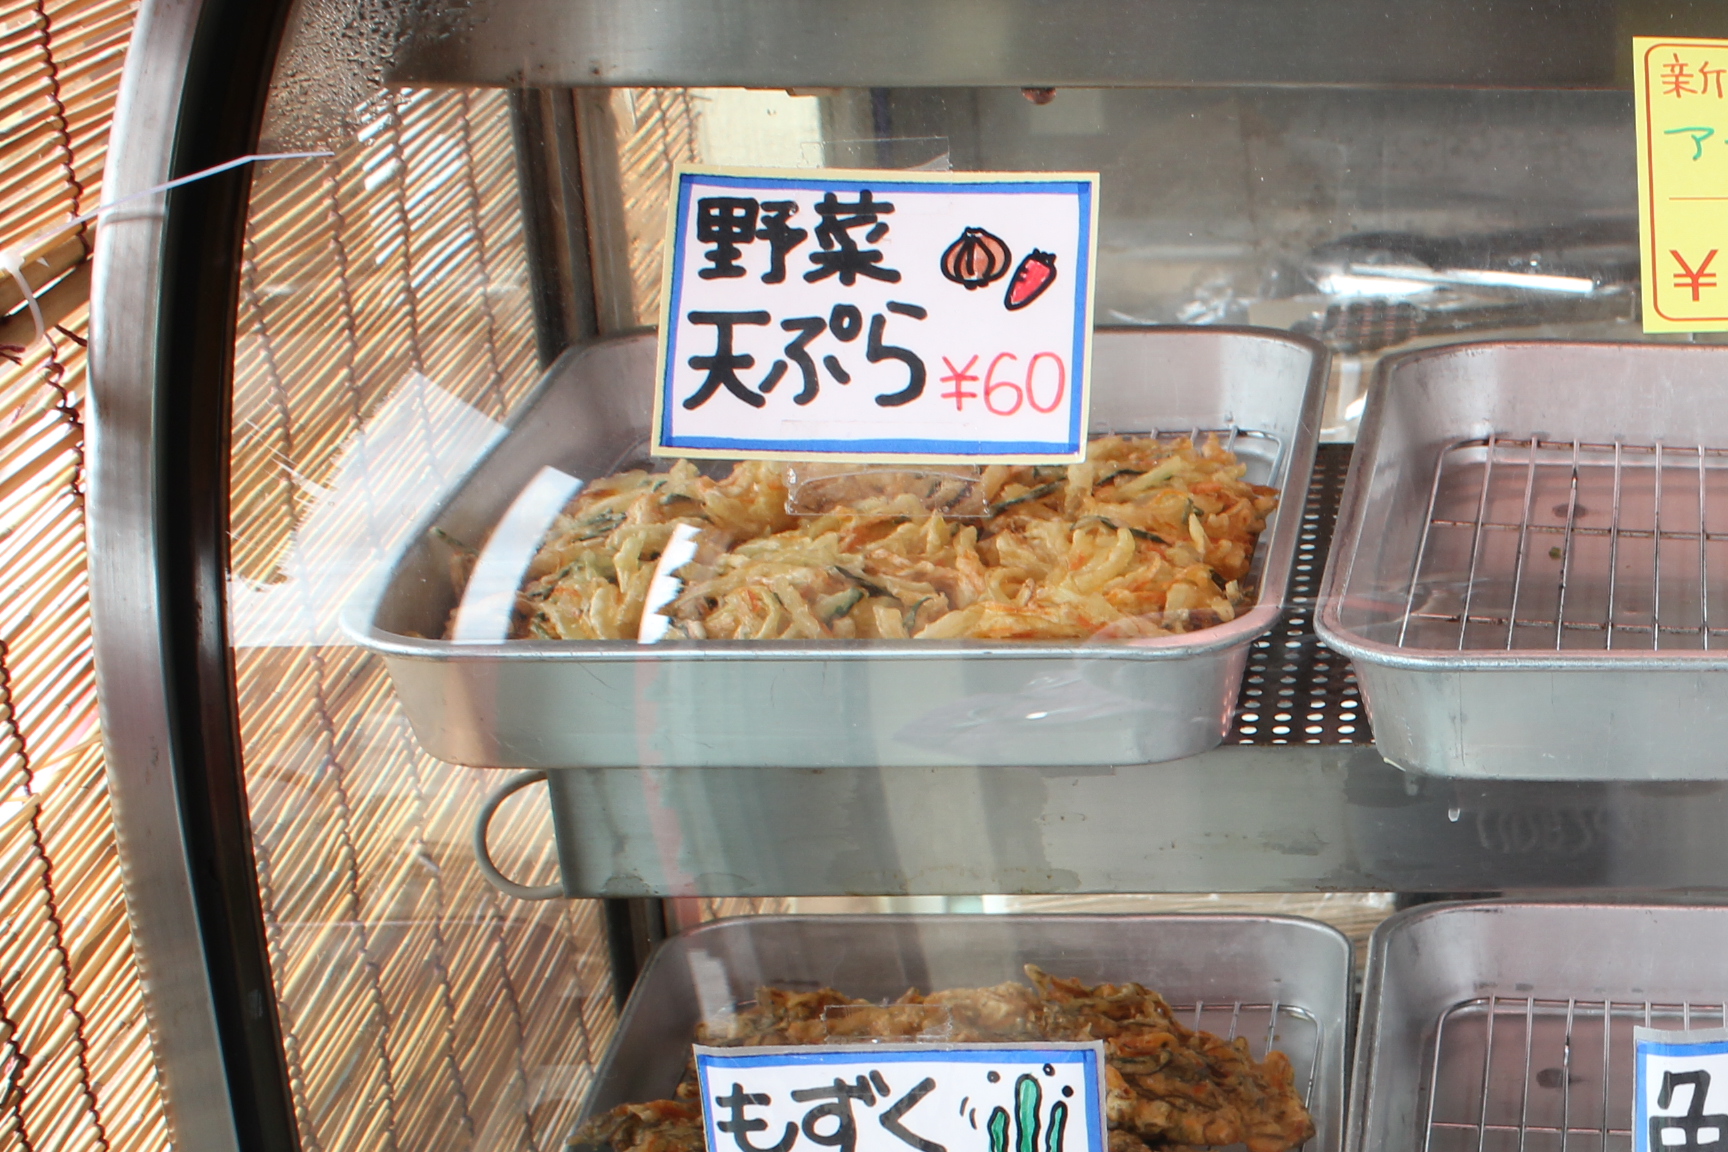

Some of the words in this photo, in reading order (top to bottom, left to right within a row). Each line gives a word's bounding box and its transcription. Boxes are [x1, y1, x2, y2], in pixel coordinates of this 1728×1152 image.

[696, 190, 901, 286] 野菜
[682, 301, 928, 410] 天ぷら
[940, 352, 1066, 417] ¥60
